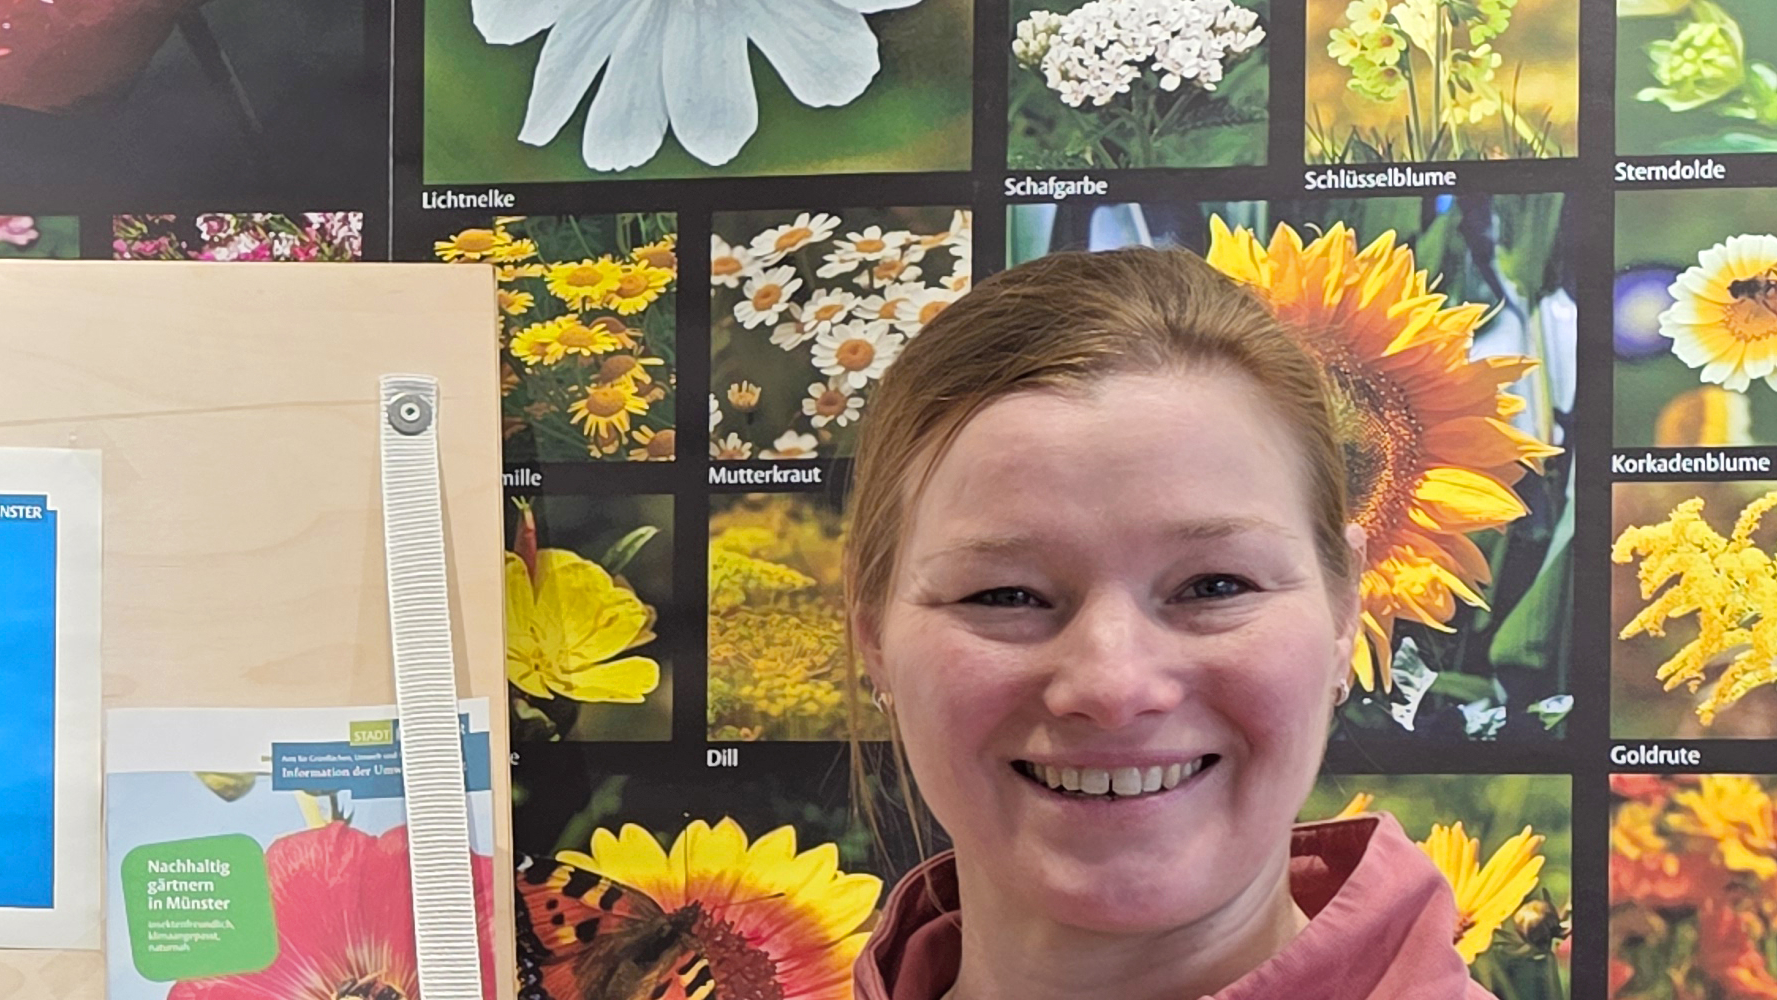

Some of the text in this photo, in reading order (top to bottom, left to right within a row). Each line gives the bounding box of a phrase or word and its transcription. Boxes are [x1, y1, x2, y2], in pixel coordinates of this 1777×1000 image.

[1304, 166, 1457, 190] Schlüsselblume
[1614, 158, 1726, 181] Sterndolde
[1004, 175, 1108, 200] Schafgarbe
[422, 188, 515, 210] Lichtnelke
[1611, 451, 1771, 473] Korkadenblume
[708, 464, 822, 484] Mutterkraut
[354, 729, 390, 743] STADT
[706, 748, 738, 767] Dill
[1610, 744, 1701, 765] Goldrute
[282, 766, 350, 778] Information
[352, 766, 371, 777] der
[147, 858, 231, 877] Nachhaltig
[147, 878, 214, 895] gärtnern
[148, 896, 231, 910] in Münster
